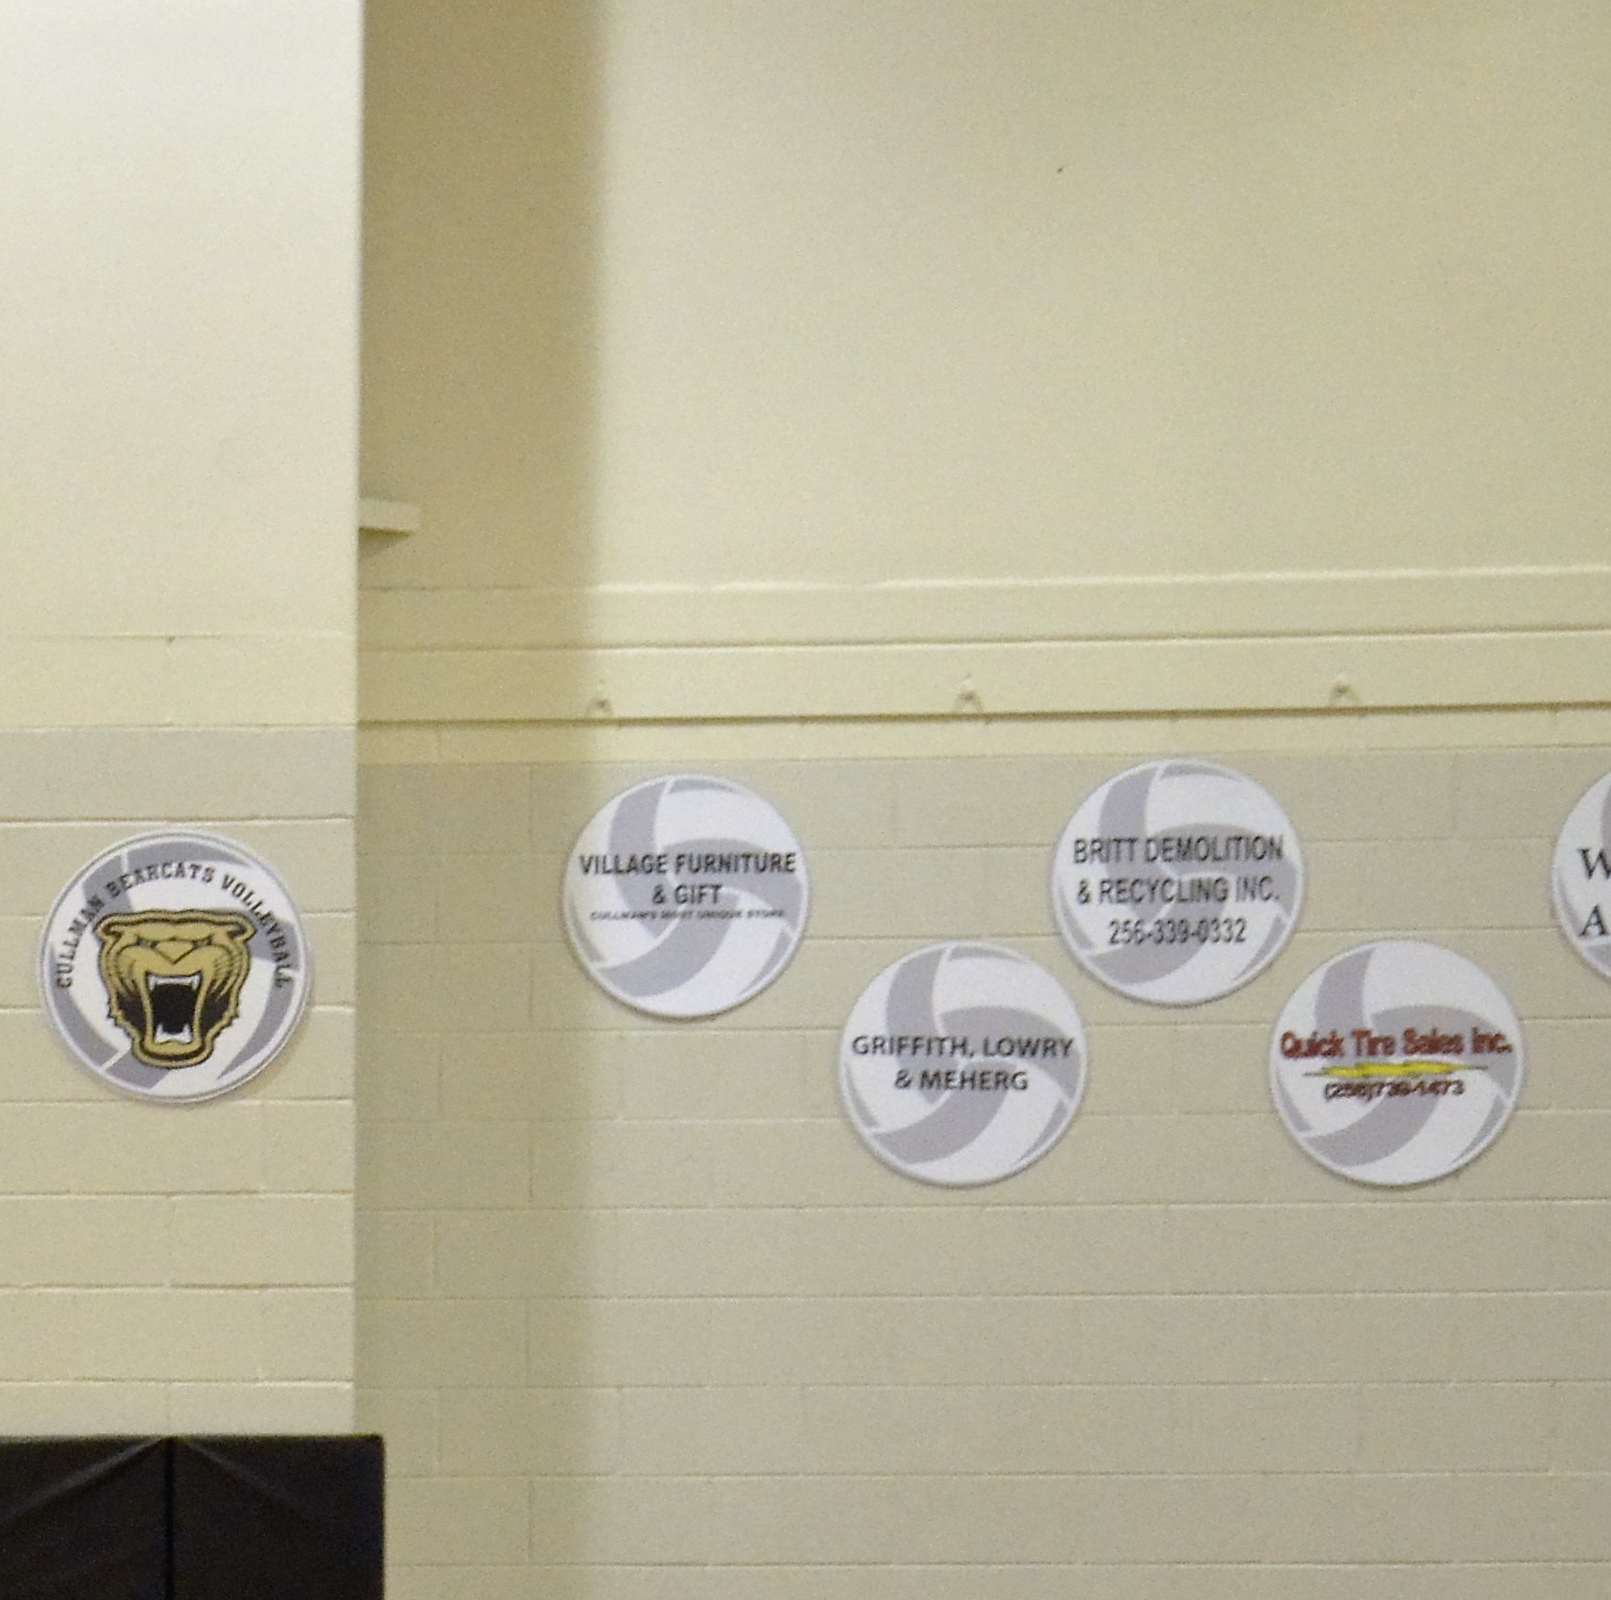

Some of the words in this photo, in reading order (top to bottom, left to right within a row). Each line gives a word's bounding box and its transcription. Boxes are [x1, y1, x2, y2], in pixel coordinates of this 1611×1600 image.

[1074, 837, 1137, 863] BRITT
[1144, 834, 1283, 862] DEMOLITION
[579, 853, 668, 874] VILLAGE
[674, 852, 796, 874] FURNITURE
[652, 883, 667, 904] &
[675, 883, 723, 904] GIFT
[1077, 880, 1090, 904] &
[1099, 877, 1229, 904] RECYCLING
[1235, 875, 1280, 901] INC.
[57, 895, 105, 989] CULLMAN
[106, 861, 214, 898] BEARCATS
[221, 874, 295, 989] VOLLEYBALL
[852, 1036, 975, 1058] GRIFFITH,
[984, 1036, 1073, 1058] LOWRY
[1281, 1030, 1345, 1059] Quick
[1352, 1028, 1396, 1056] Tire
[1402, 1027, 1465, 1055] Sales
[1471, 1025, 1513, 1053] Inc.
[894, 1068, 914, 1090] &
[919, 1070, 1029, 1091] MEHERG
